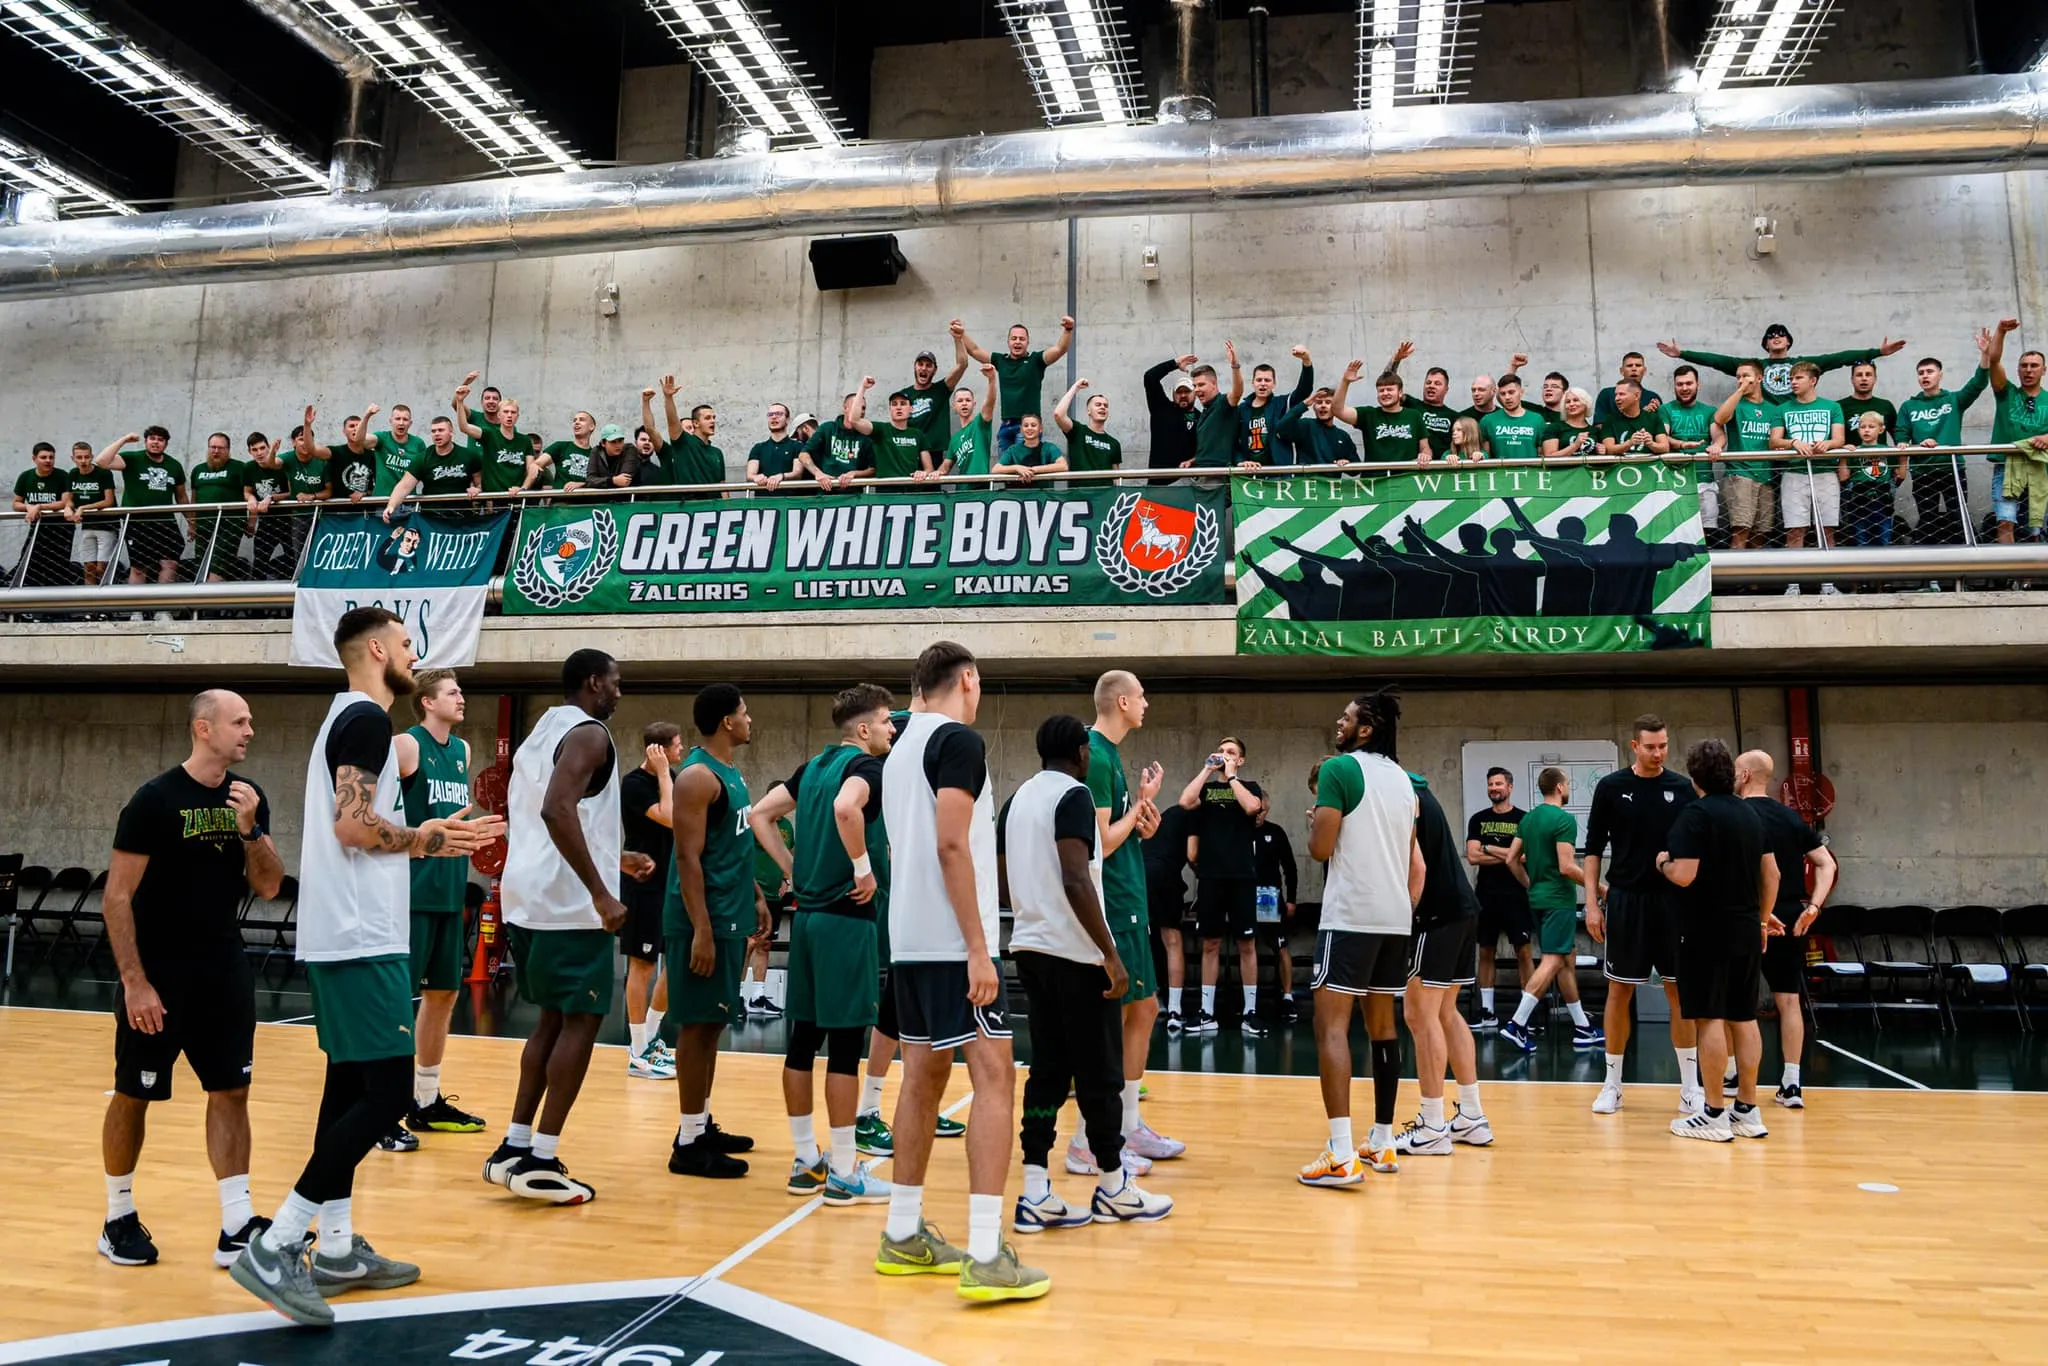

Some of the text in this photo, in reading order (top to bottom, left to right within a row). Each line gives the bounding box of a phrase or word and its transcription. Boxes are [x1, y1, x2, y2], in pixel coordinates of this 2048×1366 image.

[1242, 465, 1687, 501] GREEN WHITE BOYS
[313, 530, 490, 571] GREEN WHITE
[619, 499, 1092, 573] GREEN WHITE BOYS
[628, 581, 748, 602] ŽALGIRIS
[793, 578, 906, 599] LIETUVA
[953, 574, 1070, 595] KAUNAS
[1243, 623, 1344, 648] ŽALIAI
[1372, 627, 1462, 648] BALTI
[1493, 621, 1589, 644] ŠIRDY
[1614, 622, 1704, 643] VII
